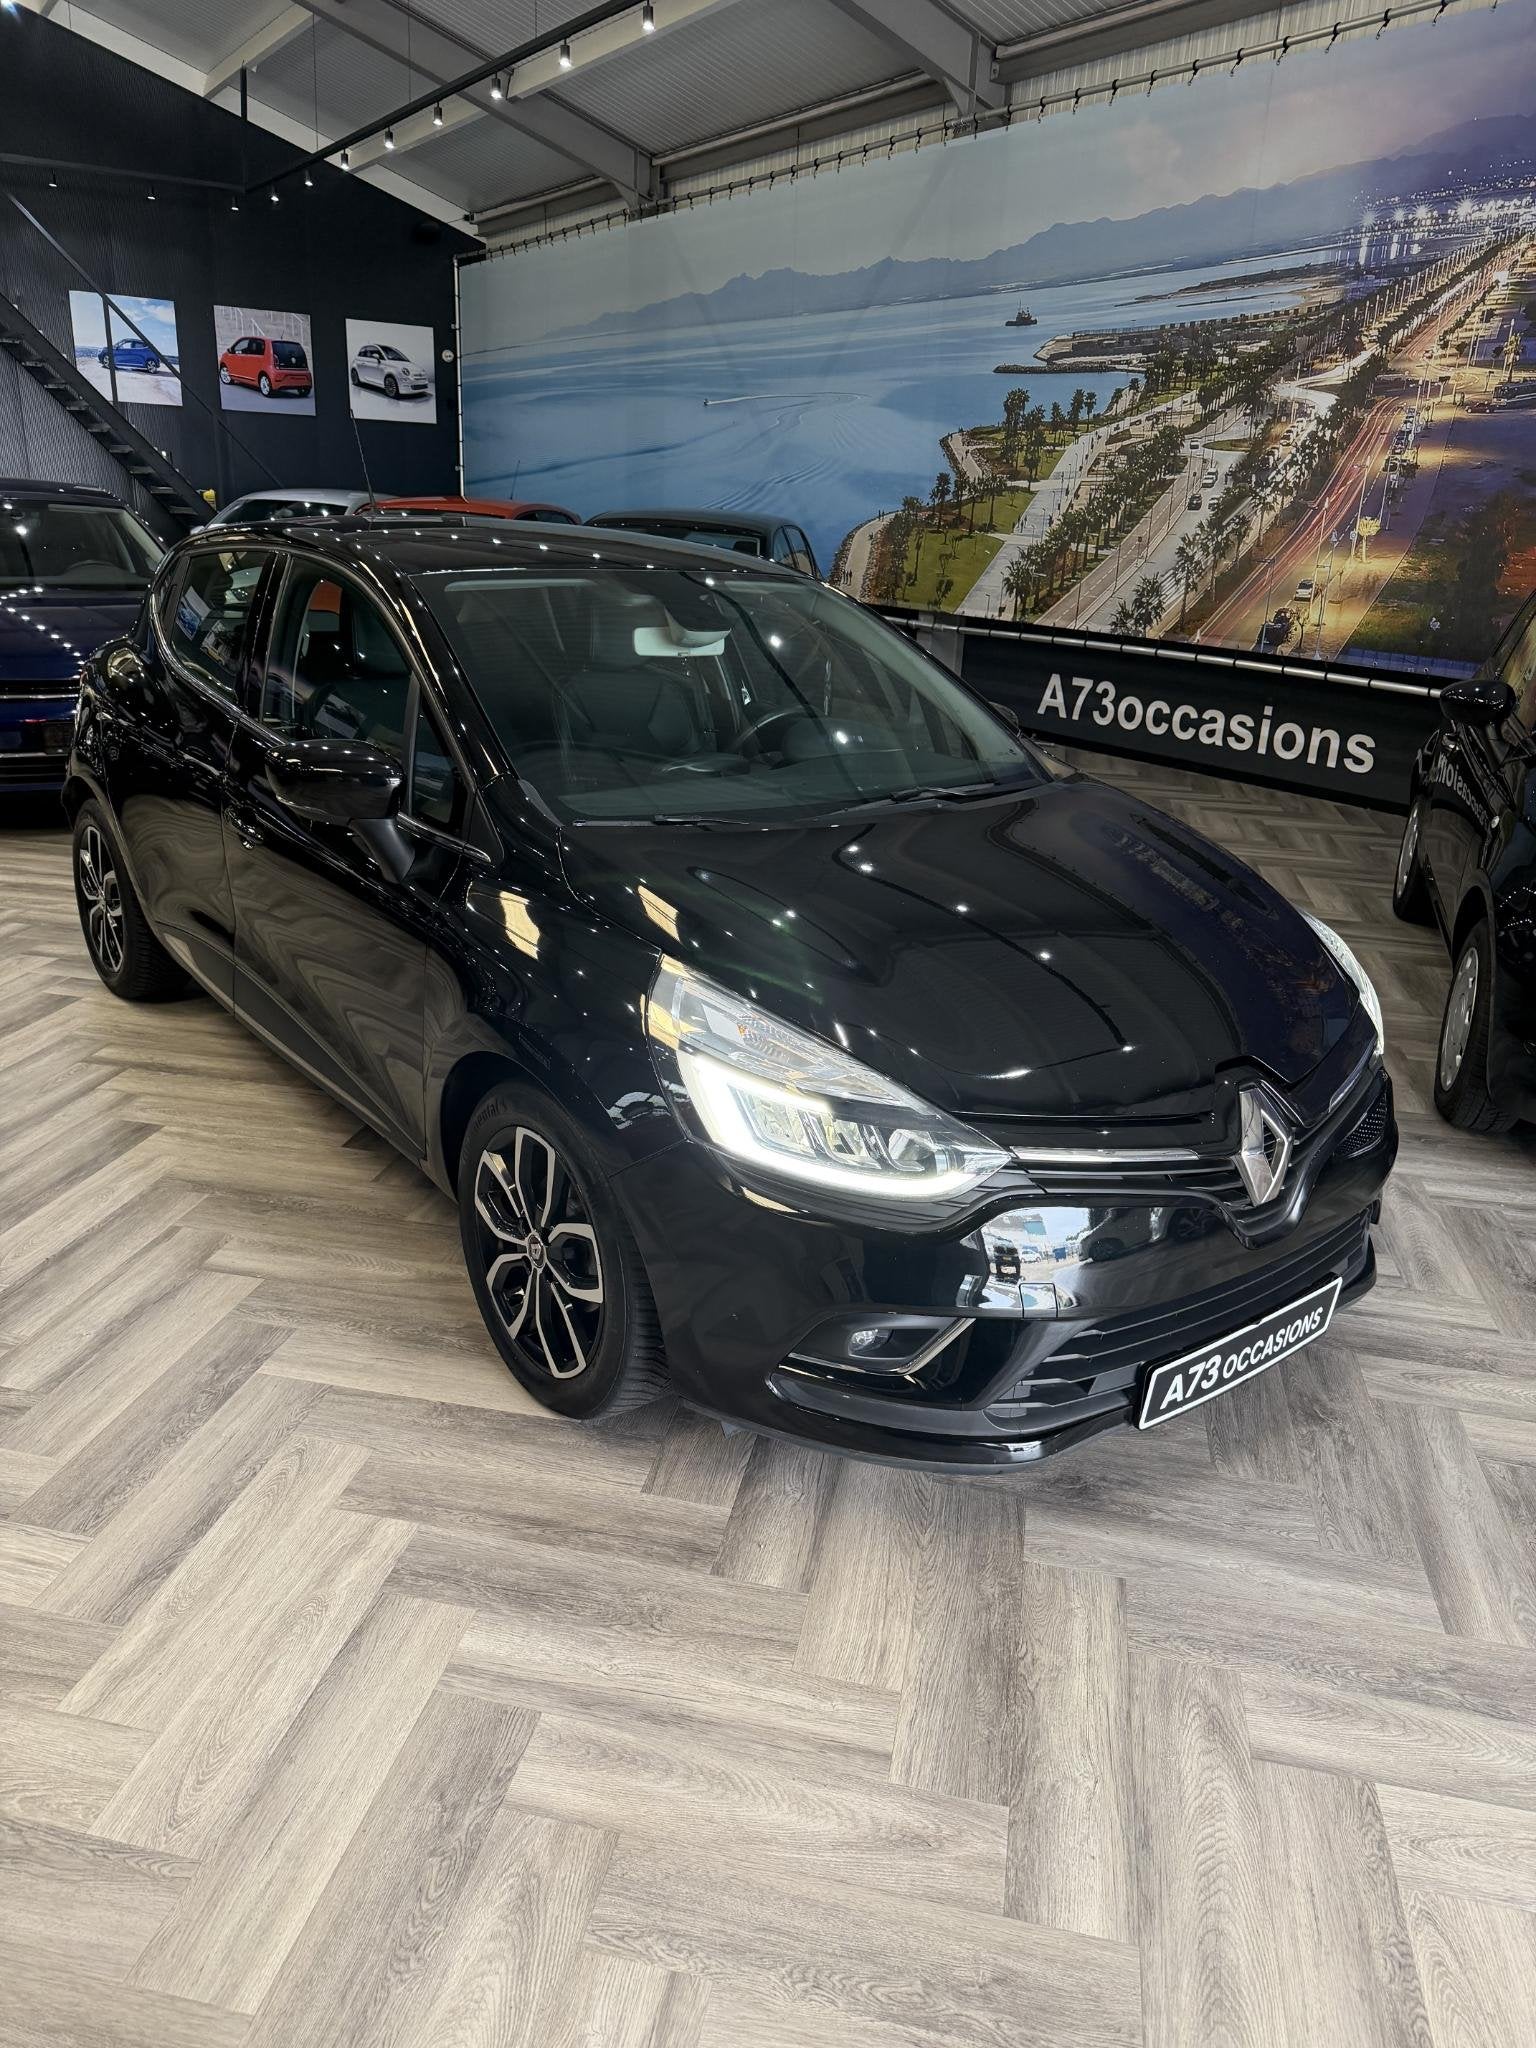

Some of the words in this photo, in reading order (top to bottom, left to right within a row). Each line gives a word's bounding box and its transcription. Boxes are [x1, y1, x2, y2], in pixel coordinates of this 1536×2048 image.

[1037, 673, 1375, 774] A73occasions
[1160, 1355, 1221, 1409] A73
[1223, 1307, 1323, 1379] OCCASIONS
